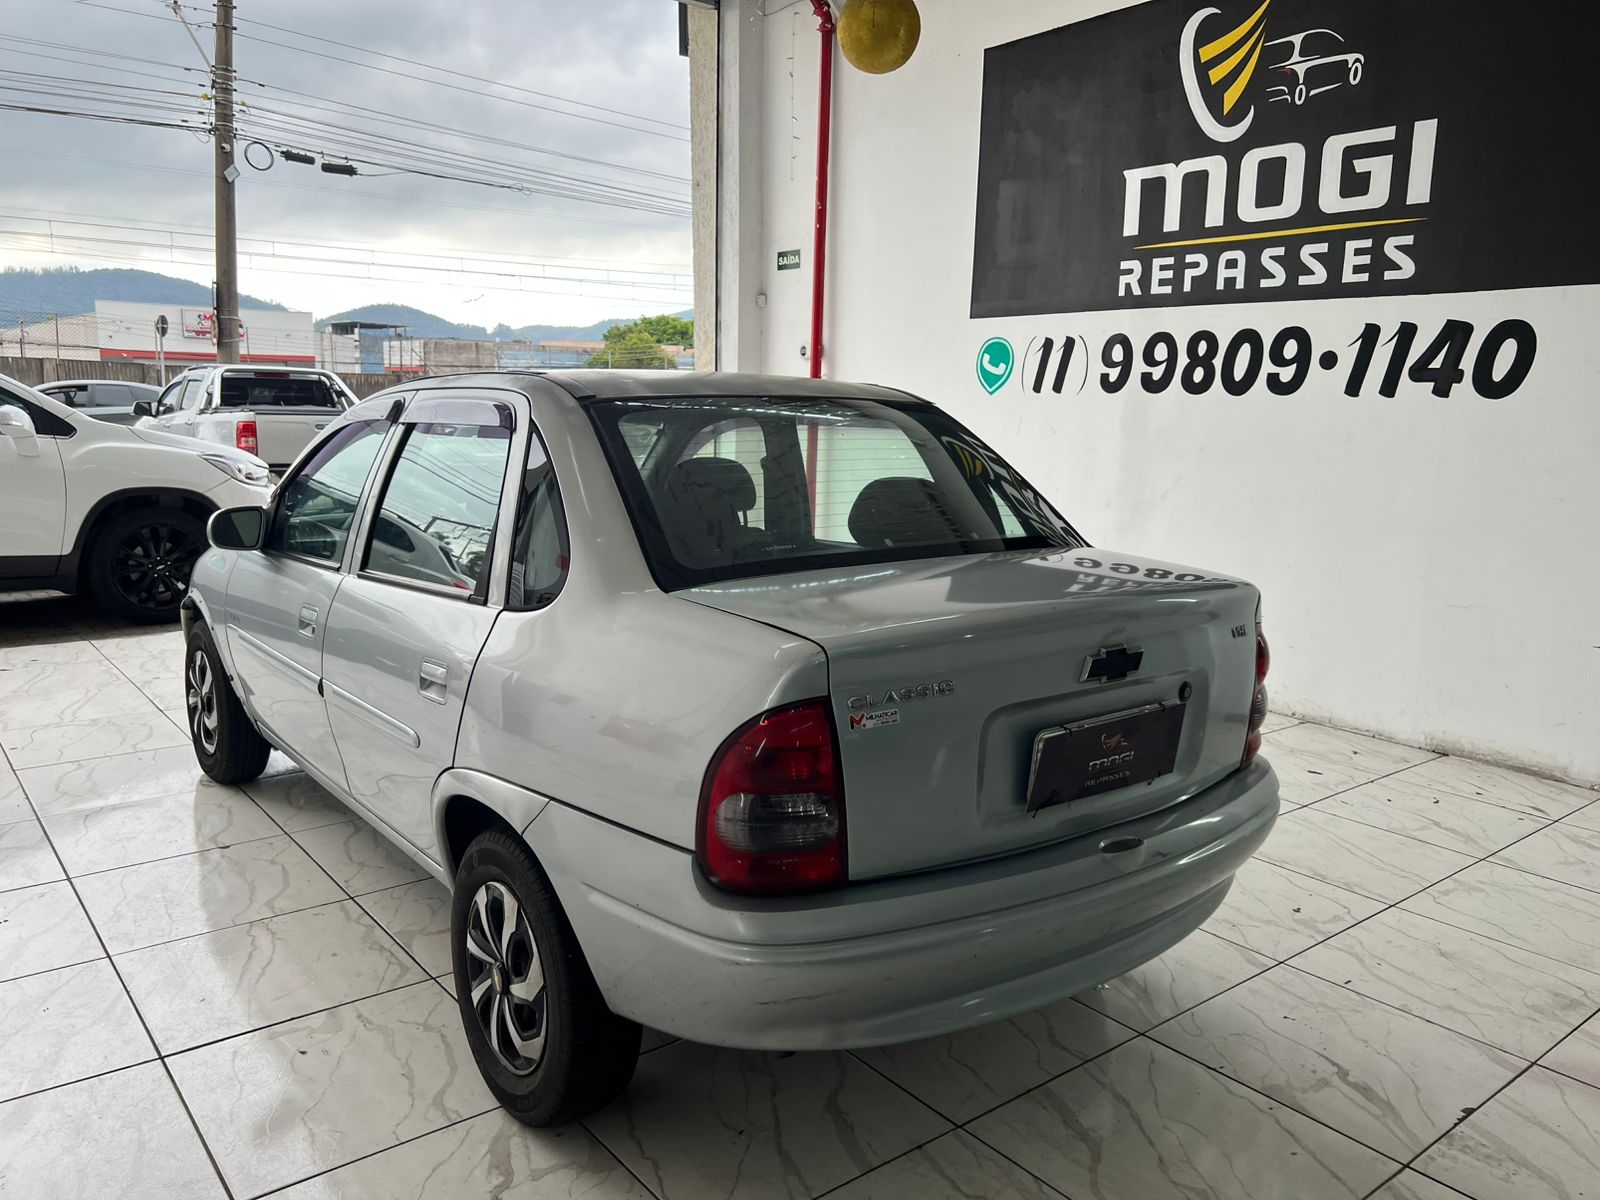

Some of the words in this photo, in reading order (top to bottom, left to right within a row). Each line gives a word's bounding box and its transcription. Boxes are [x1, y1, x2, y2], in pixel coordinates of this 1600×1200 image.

[1122, 118, 1438, 237] MOGI
[778, 254, 800, 266] SAÍDA
[1118, 235, 1416, 296] REPASSES
[1021, 335, 1088, 396] (11)
[847, 680, 955, 711] CLASSIC
